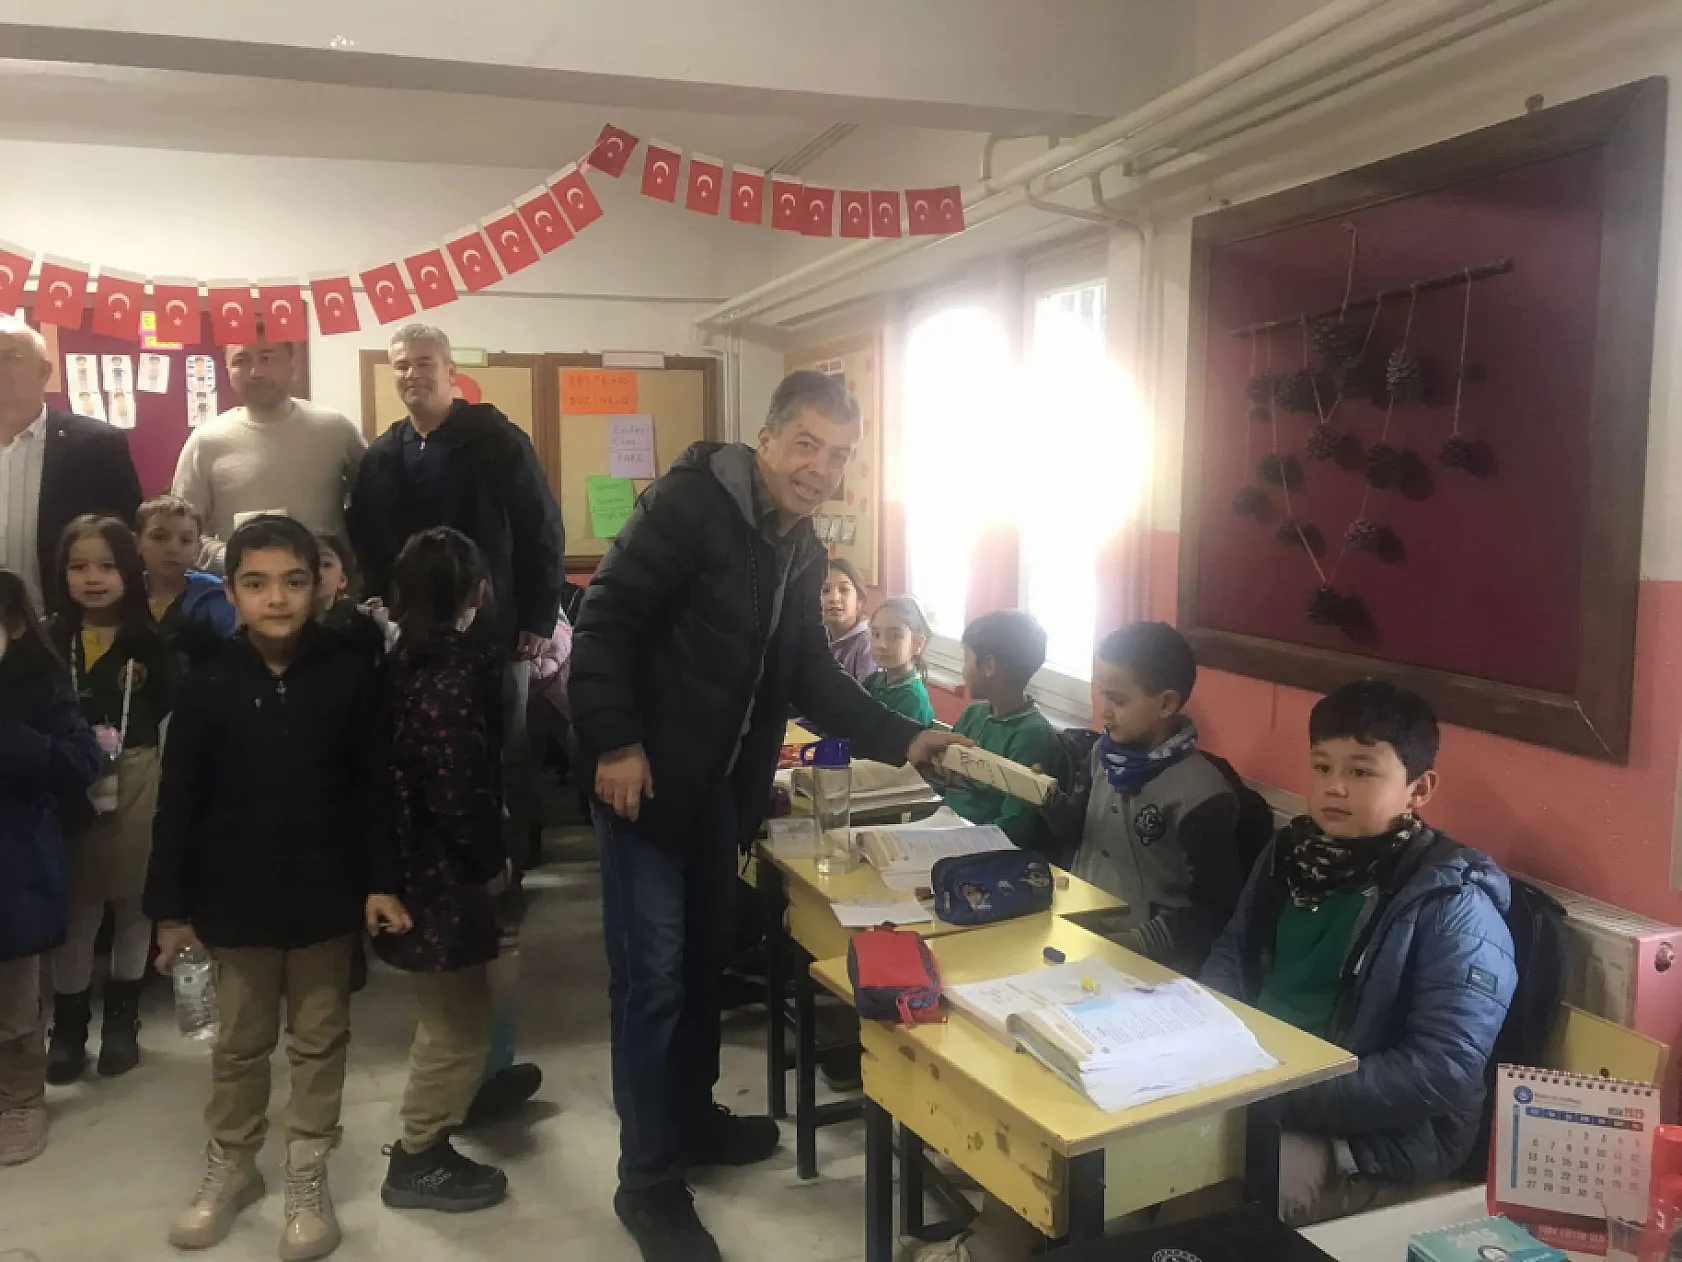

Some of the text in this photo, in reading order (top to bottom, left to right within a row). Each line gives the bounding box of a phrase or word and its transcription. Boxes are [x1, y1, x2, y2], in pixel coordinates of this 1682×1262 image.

[1528, 1152, 1538, 1161] 13
[1545, 1154, 1555, 1164] 14
[1597, 1162, 1605, 1172] 17
[1526, 1180, 1537, 1189] 27
[1596, 1177, 1604, 1185] 24
